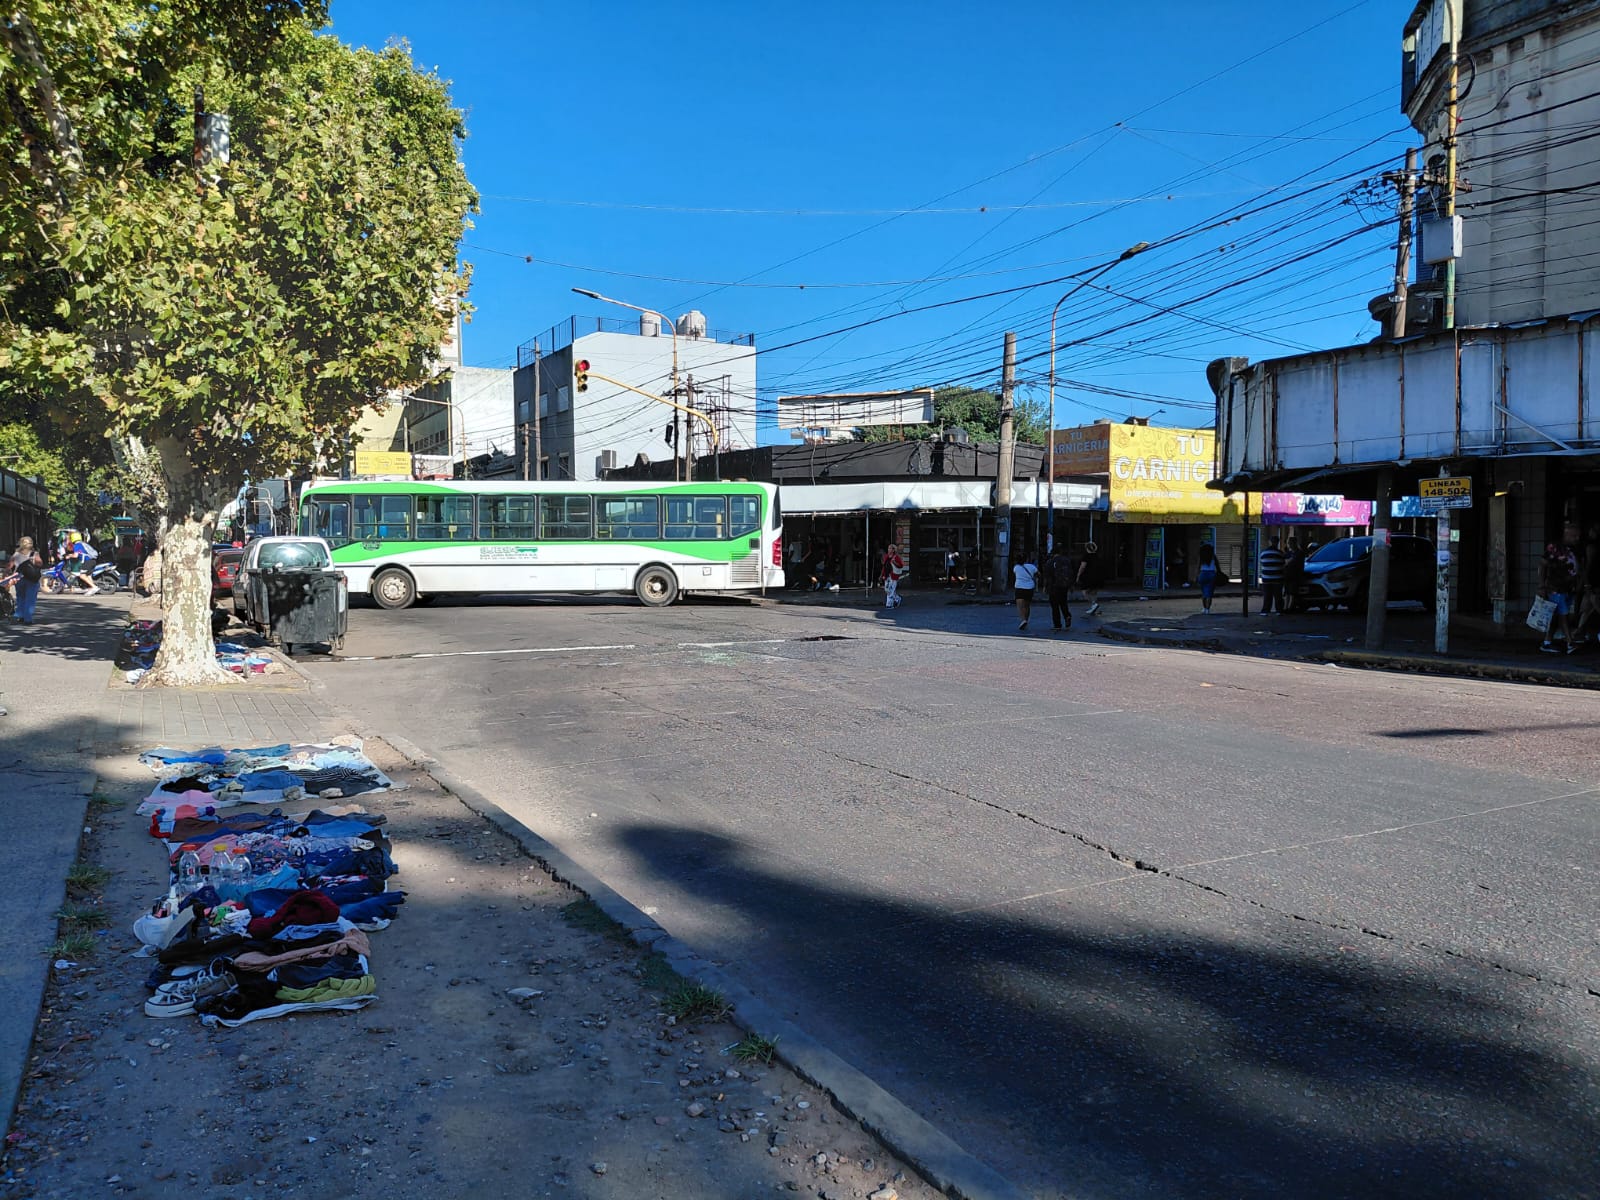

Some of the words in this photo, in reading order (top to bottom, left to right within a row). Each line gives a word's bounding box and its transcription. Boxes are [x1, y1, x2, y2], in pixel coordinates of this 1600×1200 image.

[1070, 431, 1083, 441] TU
[1176, 435, 1204, 456] TU
[1428, 480, 1462, 488] LINEAS
